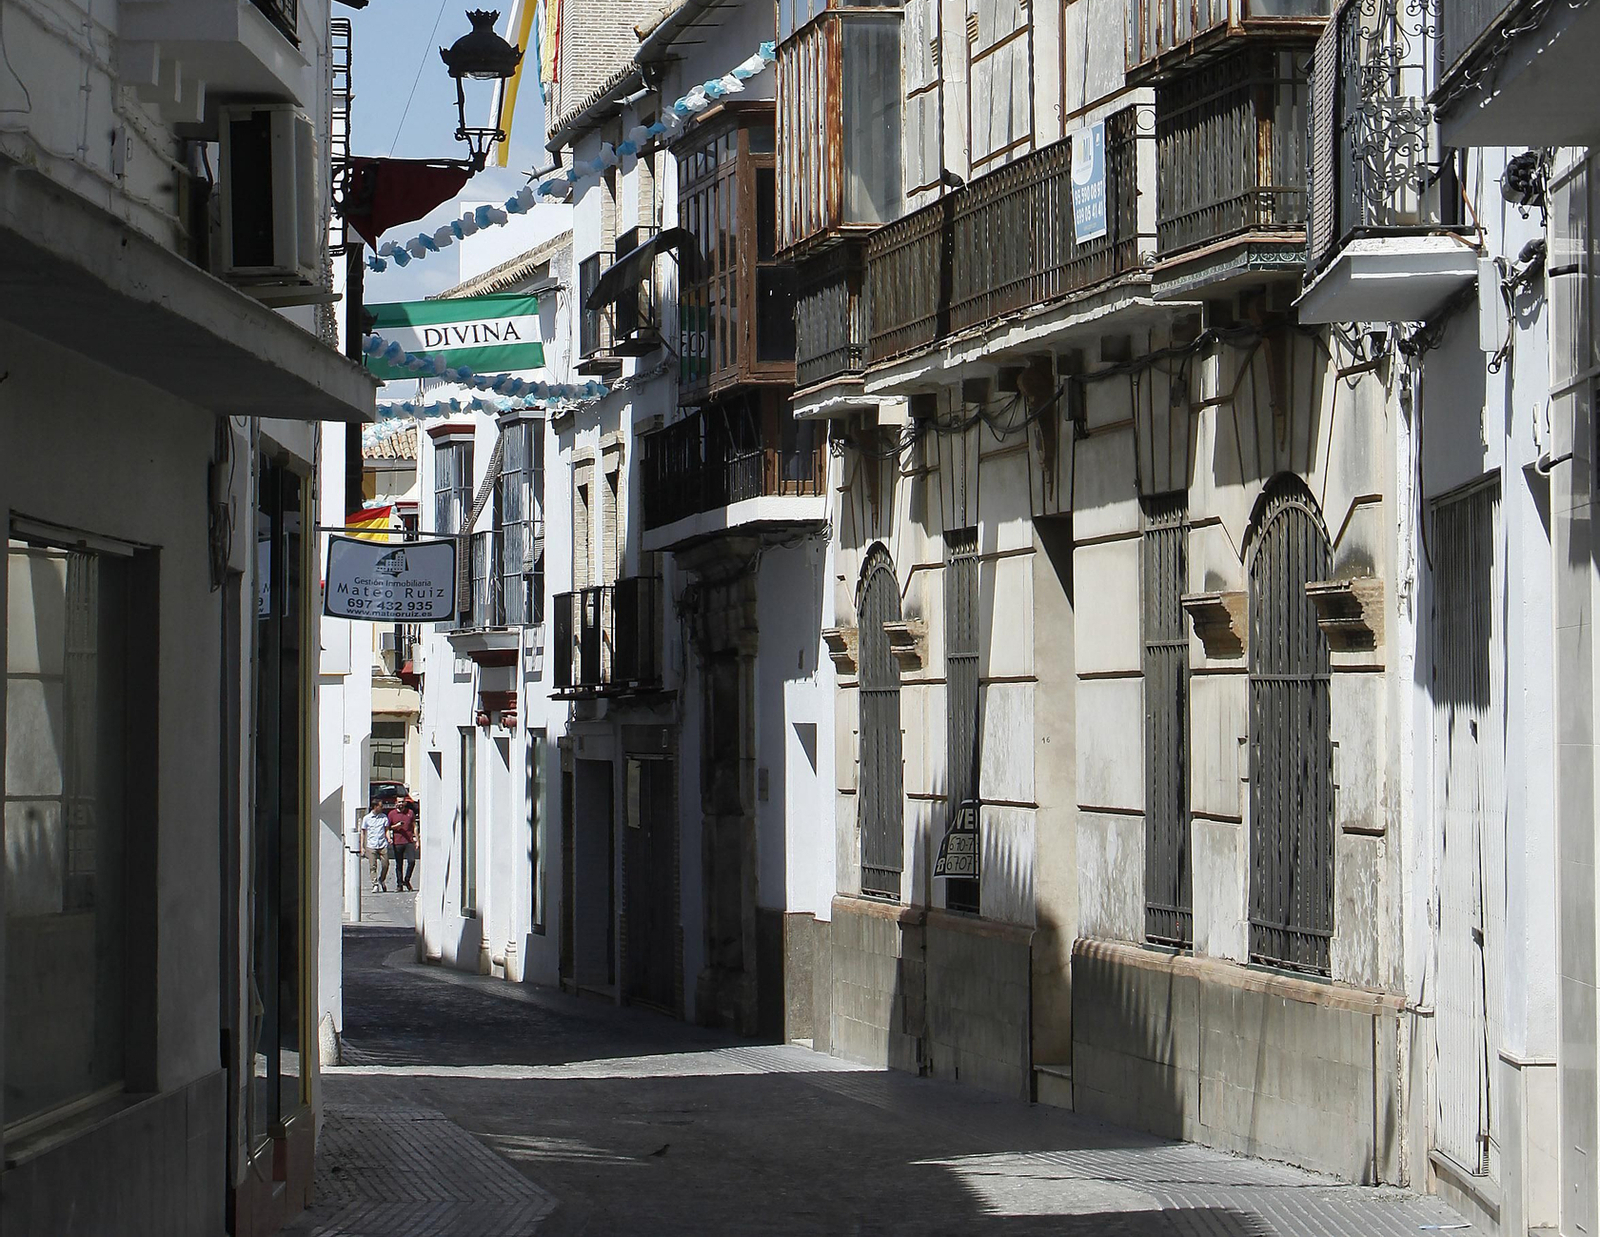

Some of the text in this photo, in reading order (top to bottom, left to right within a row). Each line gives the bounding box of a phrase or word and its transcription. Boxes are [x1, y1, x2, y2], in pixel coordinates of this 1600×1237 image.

[424, 321, 522, 348] DIVINA
[354, 576, 432, 588] Gestión Inmobiliaria
[337, 583, 445, 599] Mateo Ruiz
[347, 598, 433, 611] 697 432 935
